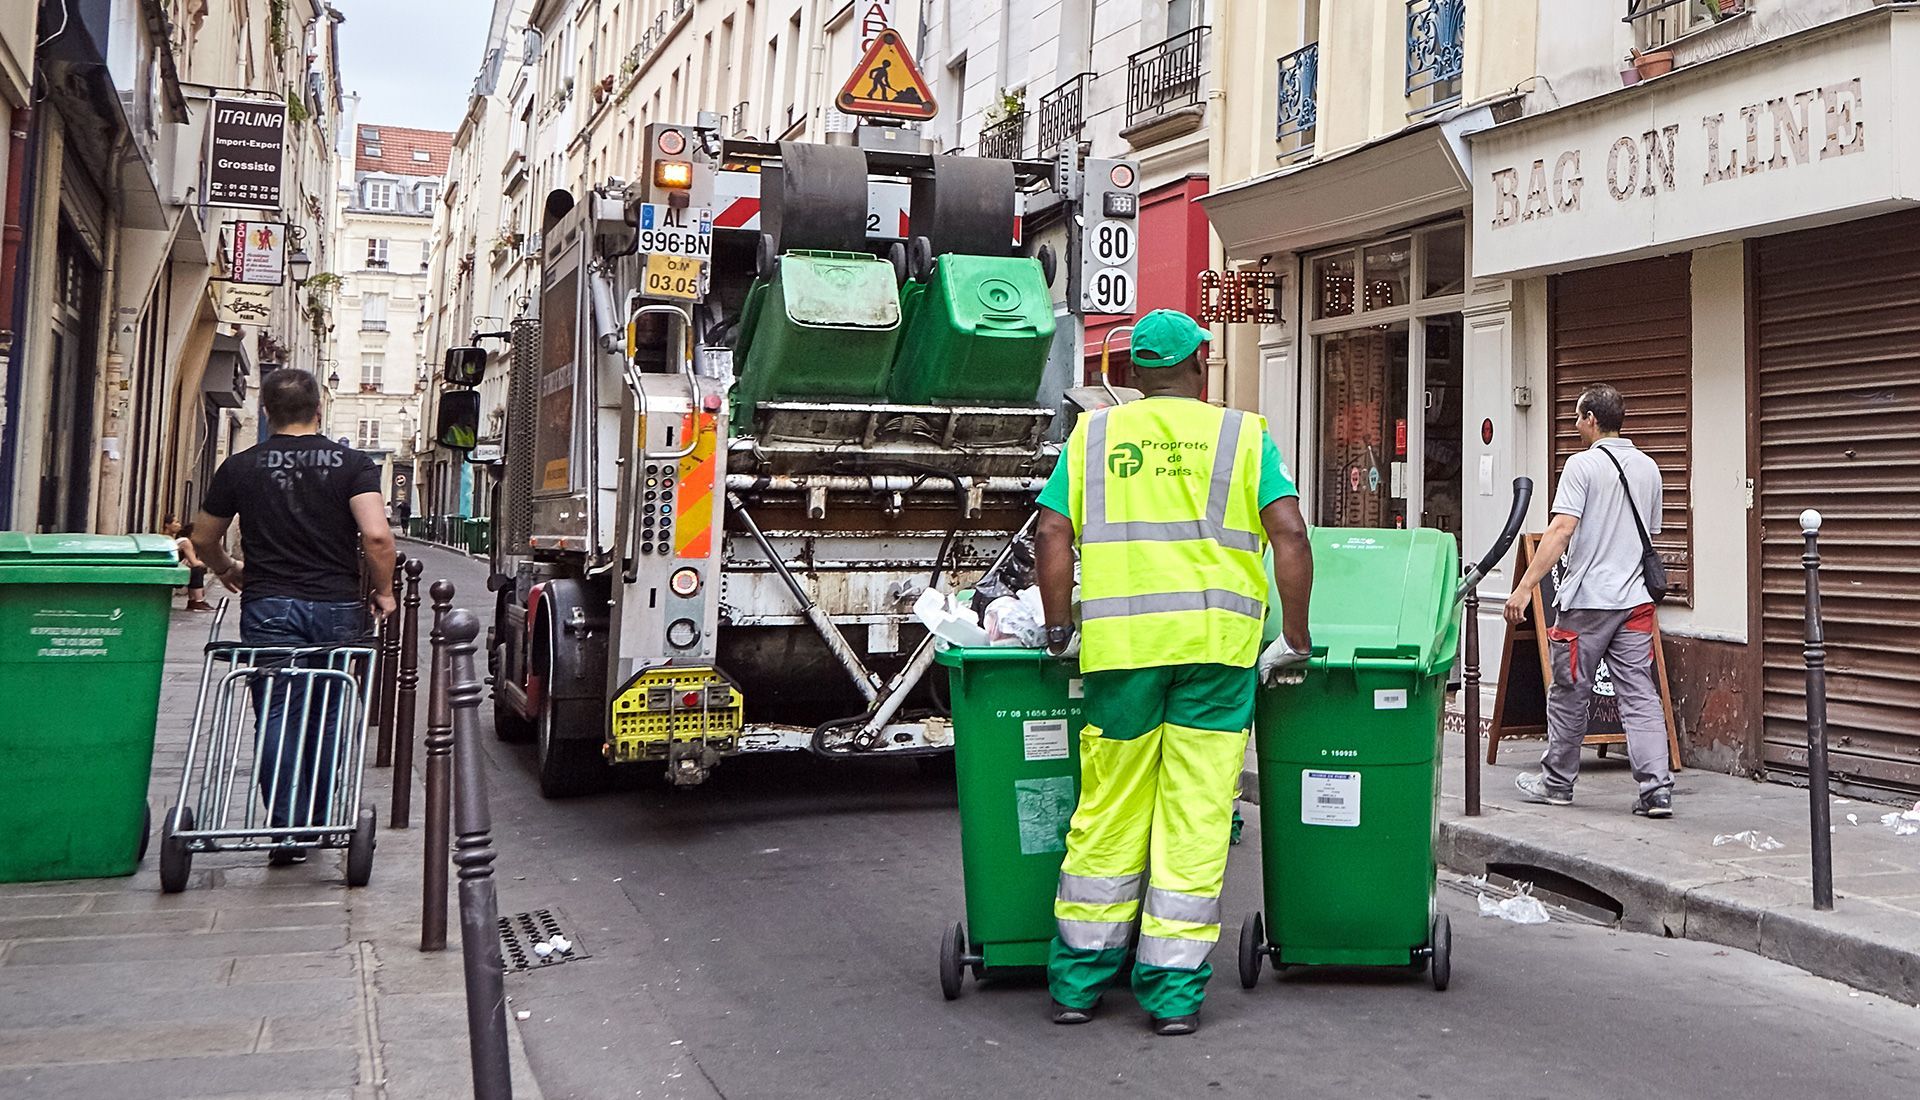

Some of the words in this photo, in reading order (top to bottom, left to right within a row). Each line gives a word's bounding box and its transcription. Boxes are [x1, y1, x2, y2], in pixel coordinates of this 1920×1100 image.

[217, 109, 283, 129] ITALINA
[216, 137, 281, 150] Import-Export
[1491, 149, 1584, 230] BAG
[1606, 124, 1680, 202] ON
[1702, 77, 1865, 186] LINE
[218, 158, 276, 173] Grossiste
[701, 223, 711, 232] 78
[641, 231, 710, 255] 996-BN
[1099, 226, 1128, 259] 80
[650, 273, 697, 294] 03.05
[1097, 274, 1126, 306] 90
[1200, 256, 1276, 323] CAFÉ
[1167, 454, 1182, 463] de
[996, 710, 1007, 718] 07
[1051, 708, 1067, 716] 240
